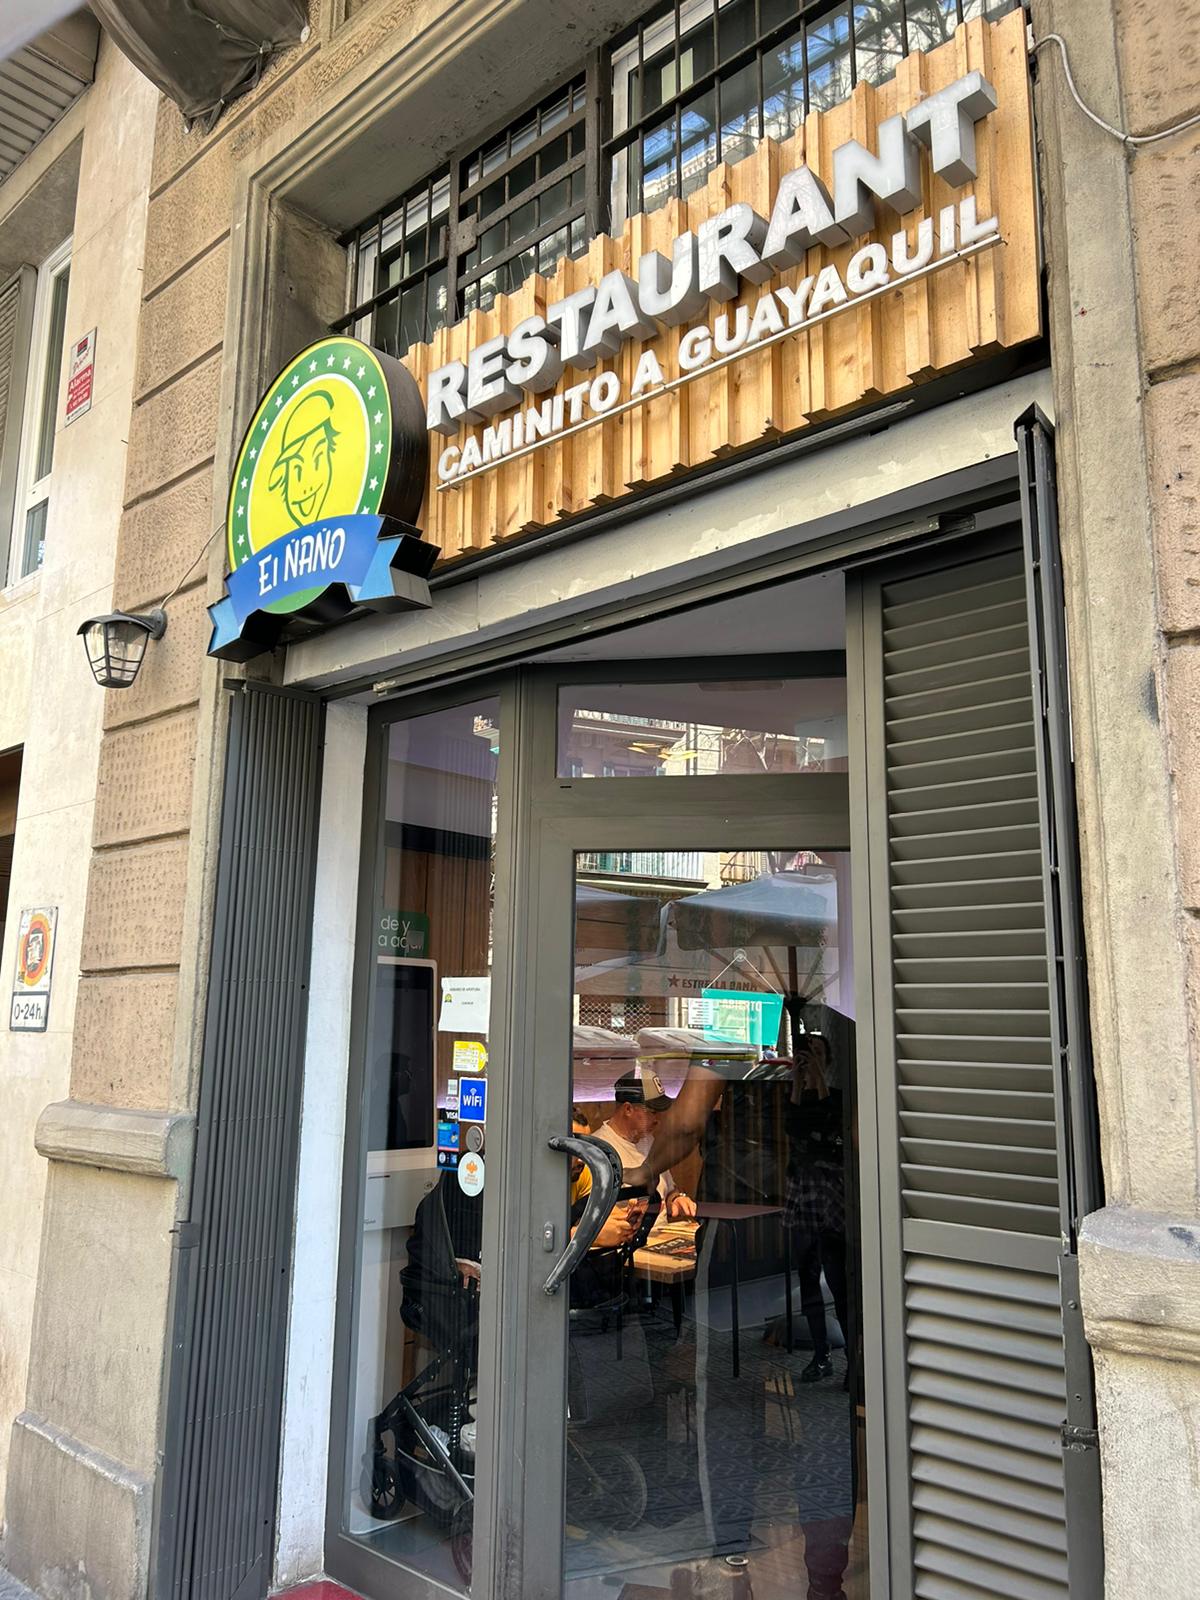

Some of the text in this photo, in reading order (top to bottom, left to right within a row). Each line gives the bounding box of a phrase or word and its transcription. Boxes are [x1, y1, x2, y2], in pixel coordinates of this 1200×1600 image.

[427, 69, 997, 434] RESTAURANT
[438, 195, 999, 481] CAMINITO A GUAYAQUIL
